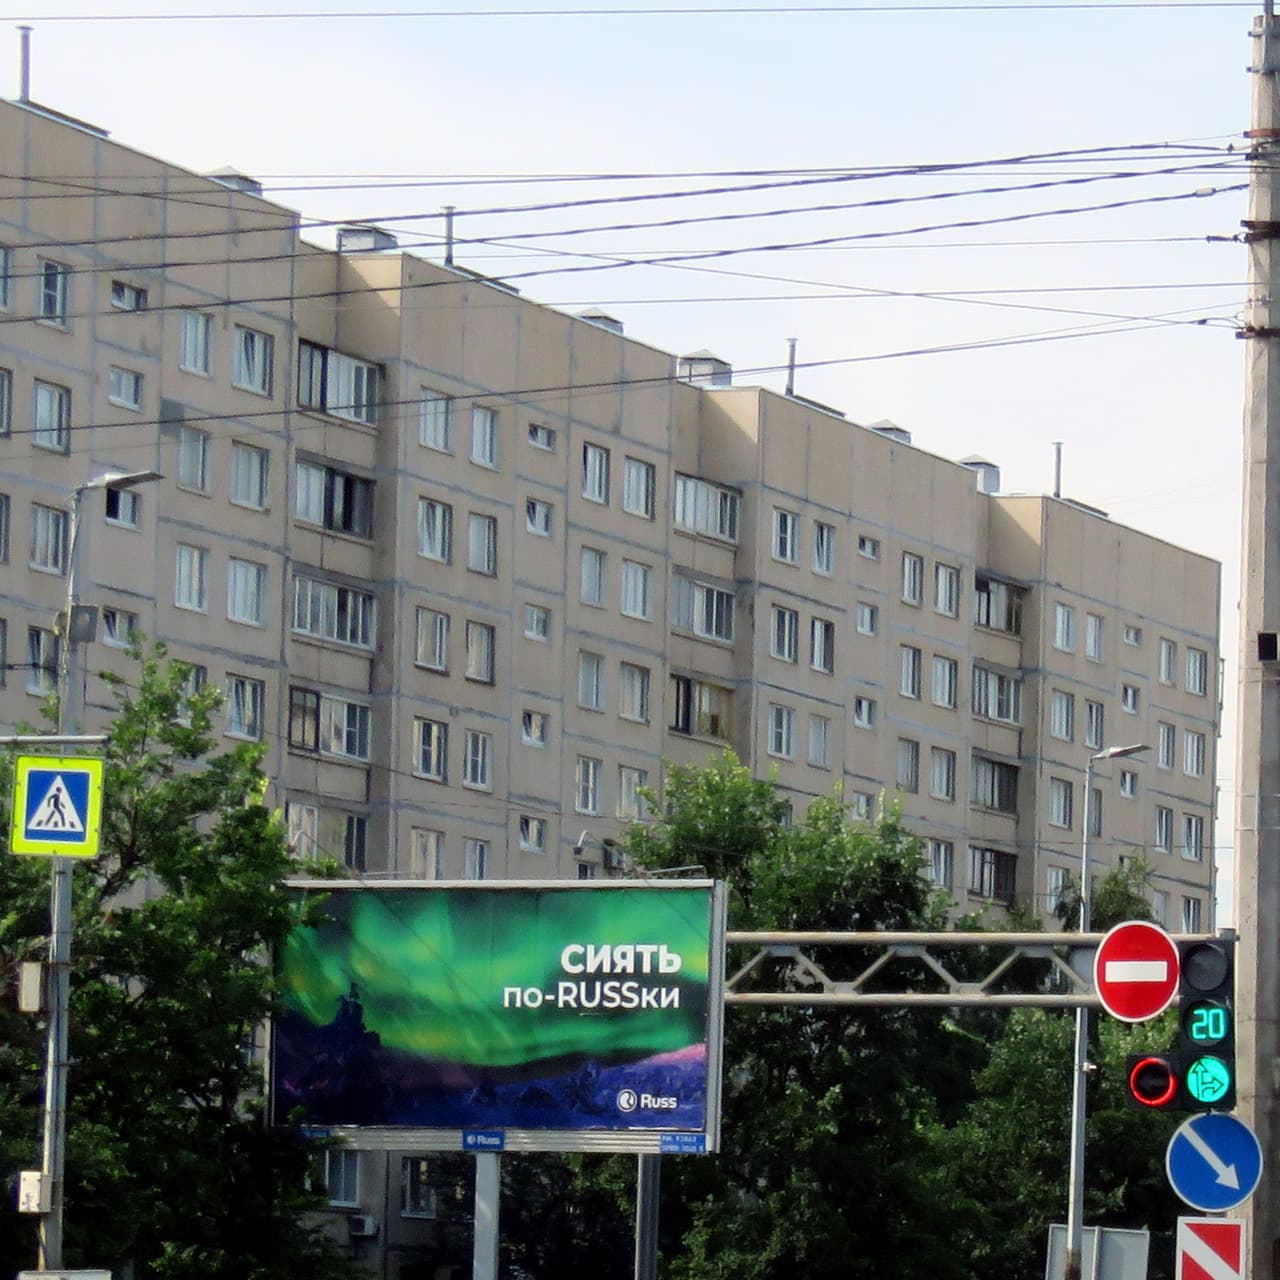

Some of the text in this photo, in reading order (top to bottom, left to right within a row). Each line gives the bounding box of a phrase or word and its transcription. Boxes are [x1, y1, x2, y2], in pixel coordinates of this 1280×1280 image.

[561, 943, 682, 974] СИЯТЬ
[503, 981, 680, 1009] по-RUSSки
[1192, 1008, 1225, 1040] 20
[641, 1093, 677, 1109] Russ
[478, 1135, 500, 1145] Russ
